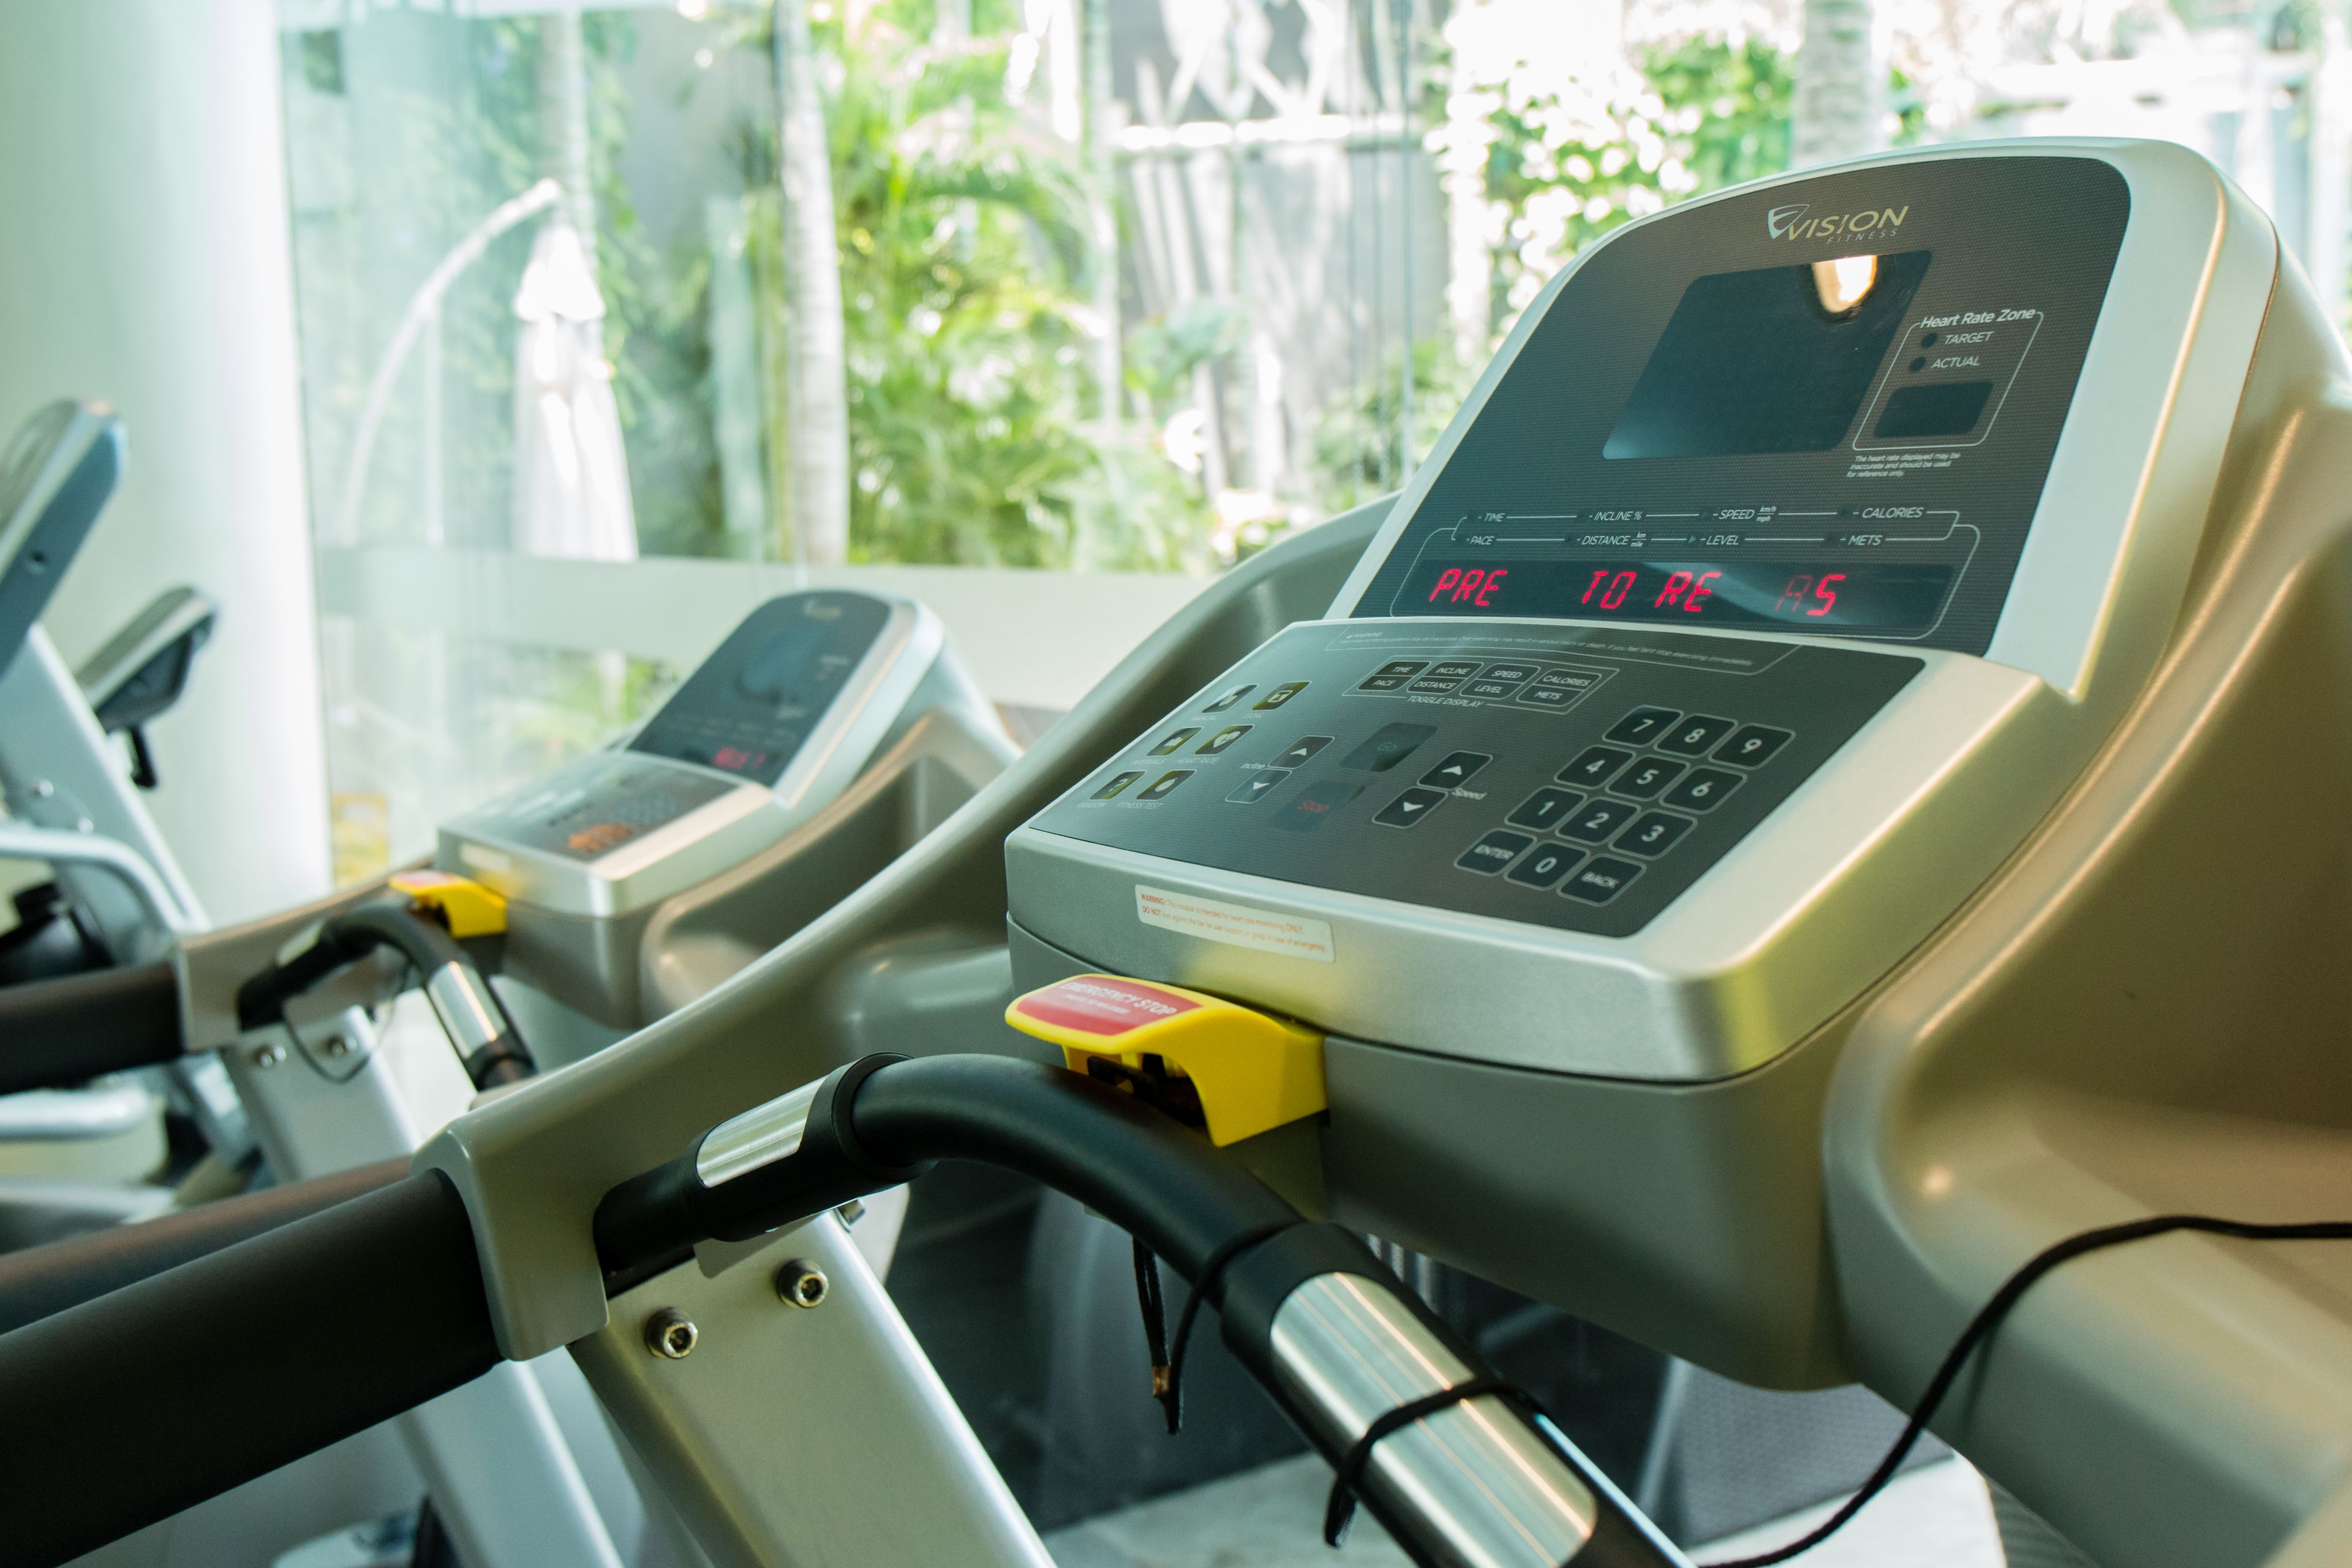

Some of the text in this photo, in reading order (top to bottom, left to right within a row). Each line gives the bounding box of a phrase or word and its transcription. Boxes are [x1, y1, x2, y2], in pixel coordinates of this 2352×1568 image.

[1789, 206, 1909, 240] VISION
[1826, 228, 1898, 244] FITNESS
[1920, 309, 2036, 328] Heart Rate Zone
[1945, 331, 1994, 345] TARGET
[1931, 356, 1980, 369] ACTUAL
[1484, 513, 1506, 522] TIME
[1594, 511, 1643, 521] INCLINE %
[1719, 510, 1755, 519] SPEED
[1755, 514, 1771, 523] mph
[1861, 507, 1924, 518] CALORIES
[1470, 535, 1494, 545] PACE
[1581, 535, 1630, 545] DISTANCE
[1706, 535, 1739, 545] LEVEL
[1847, 535, 1883, 546] METS
[1429, 568, 1509, 606] PRE
[1582, 570, 1637, 609] TO
[1655, 571, 1722, 612] RE
[1492, 670, 1522, 679] SPEED
[1543, 675, 1591, 686] CALORIES
[1414, 680, 1457, 690] DISTANCE
[1474, 685, 1503, 693] LEVEL
[1408, 695, 1485, 707] TOGGLE DISPLAY
[1534, 691, 1562, 699] METS
[1632, 718, 1654, 733] 7
[1684, 728, 1706, 744] 8
[1378, 741, 1397, 752] Go
[1740, 738, 1763, 754] 9
[1240, 762, 1265, 771] Incline
[1585, 759, 1606, 774] 4
[1636, 769, 1660, 785] 5
[1451, 786, 1488, 801] Speed
[1691, 781, 1714, 797] 6
[1537, 801, 1555, 816] 1
[1585, 812, 1610, 829] 2
[1641, 824, 1665, 842] 3
[1473, 843, 1515, 861] ENTER
[1535, 857, 1558, 873] 0
[1580, 871, 1621, 889] BACK
[1058, 981, 1144, 1004] EMERGENCY
[1133, 998, 1177, 1016] STOP
